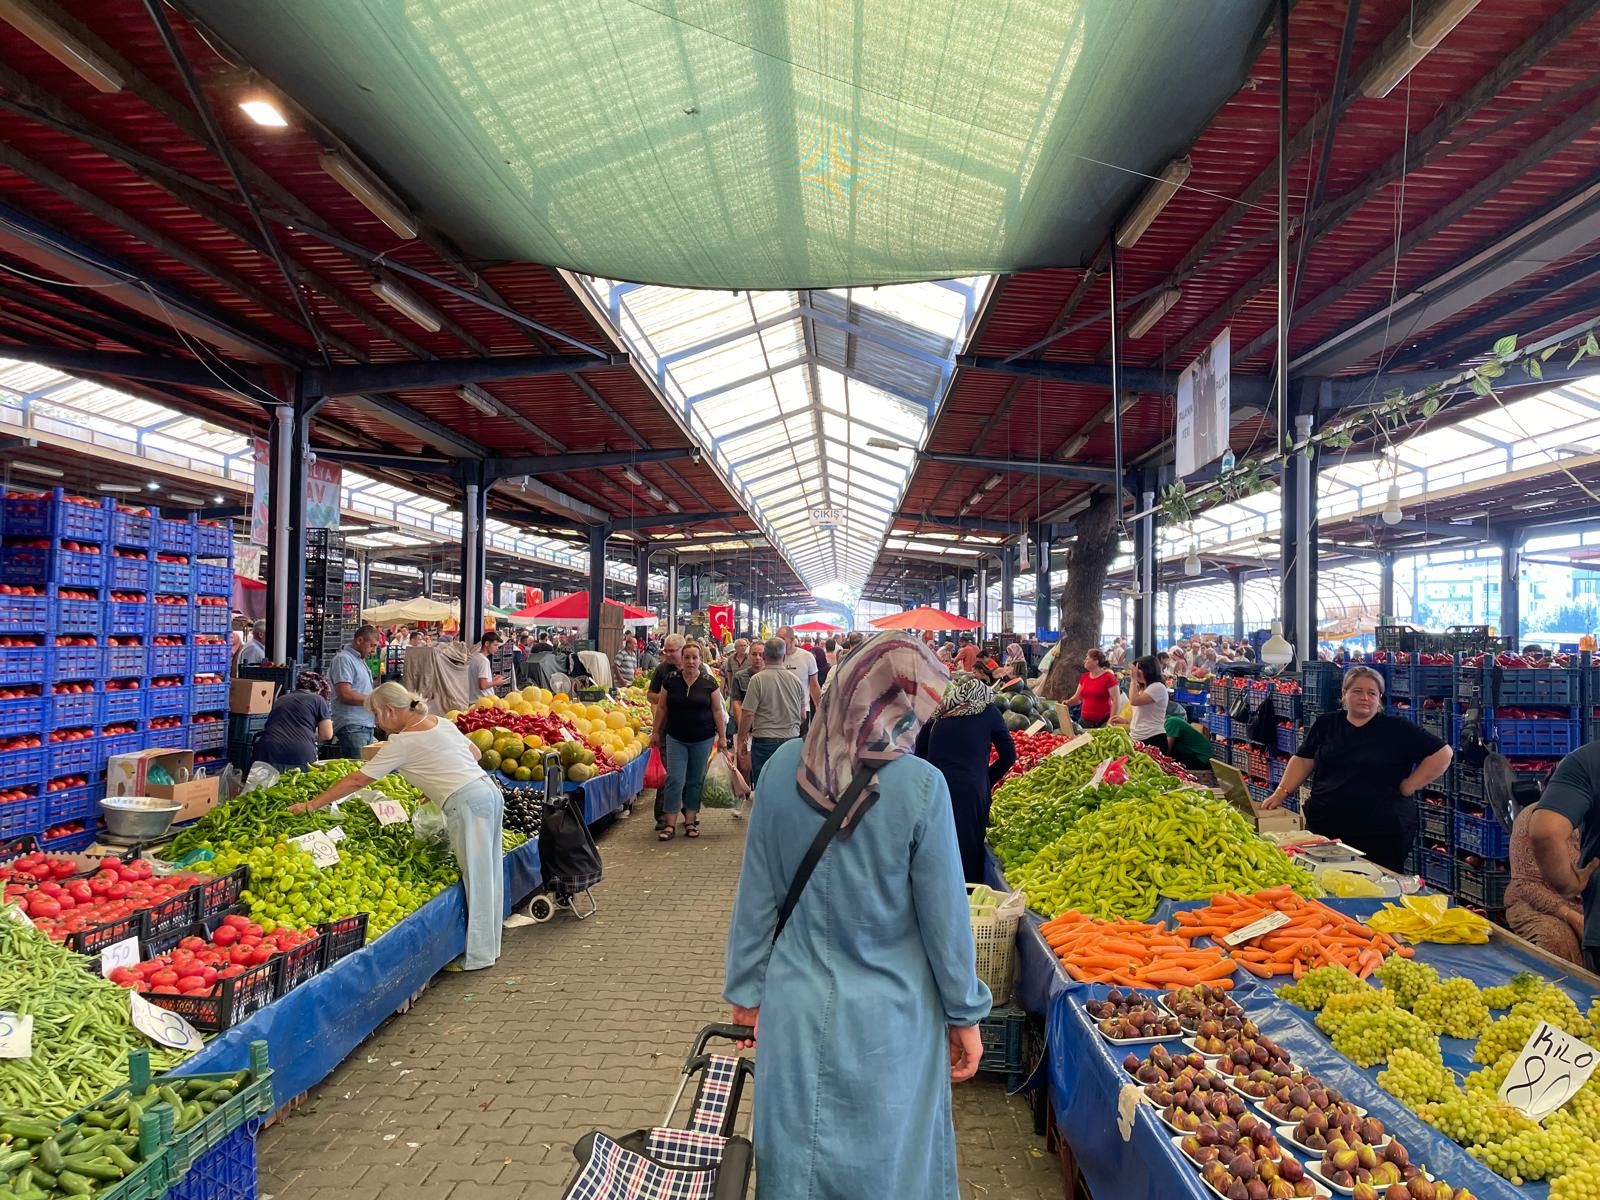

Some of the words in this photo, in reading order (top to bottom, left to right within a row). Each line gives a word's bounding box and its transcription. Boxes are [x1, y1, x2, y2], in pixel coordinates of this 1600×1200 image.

[306, 481, 326, 503] AV
[813, 510, 839, 520] ÇIKIŞ
[1505, 1055, 1571, 1115] 80
